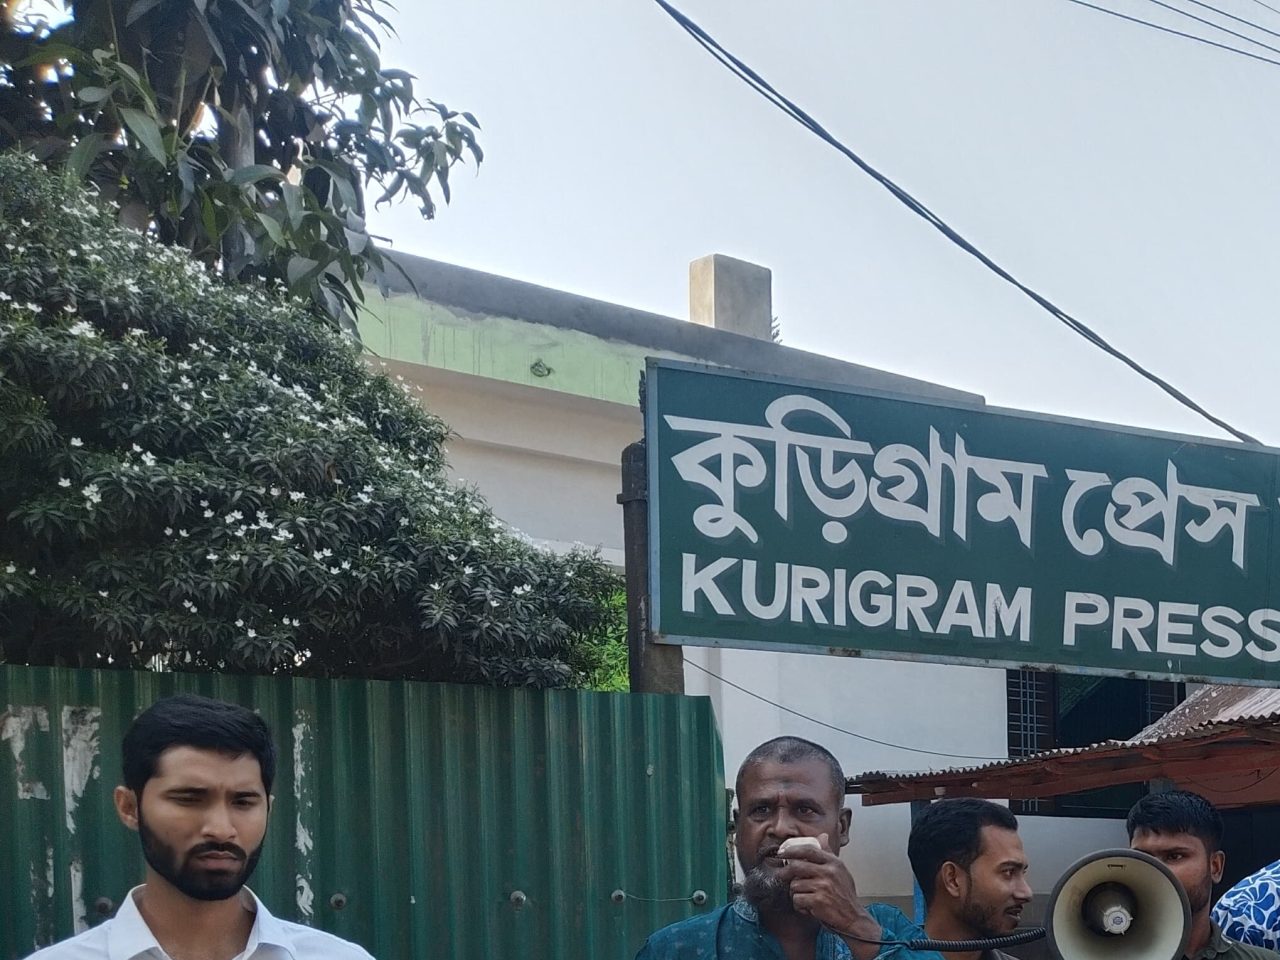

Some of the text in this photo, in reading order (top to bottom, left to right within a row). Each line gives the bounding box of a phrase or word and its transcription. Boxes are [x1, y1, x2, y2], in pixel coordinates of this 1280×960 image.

[663, 394, 1048, 549] কুড়িগ্রাম
[1062, 459, 1260, 569] প্রেস
[682, 553, 1032, 642] KURIGRAM
